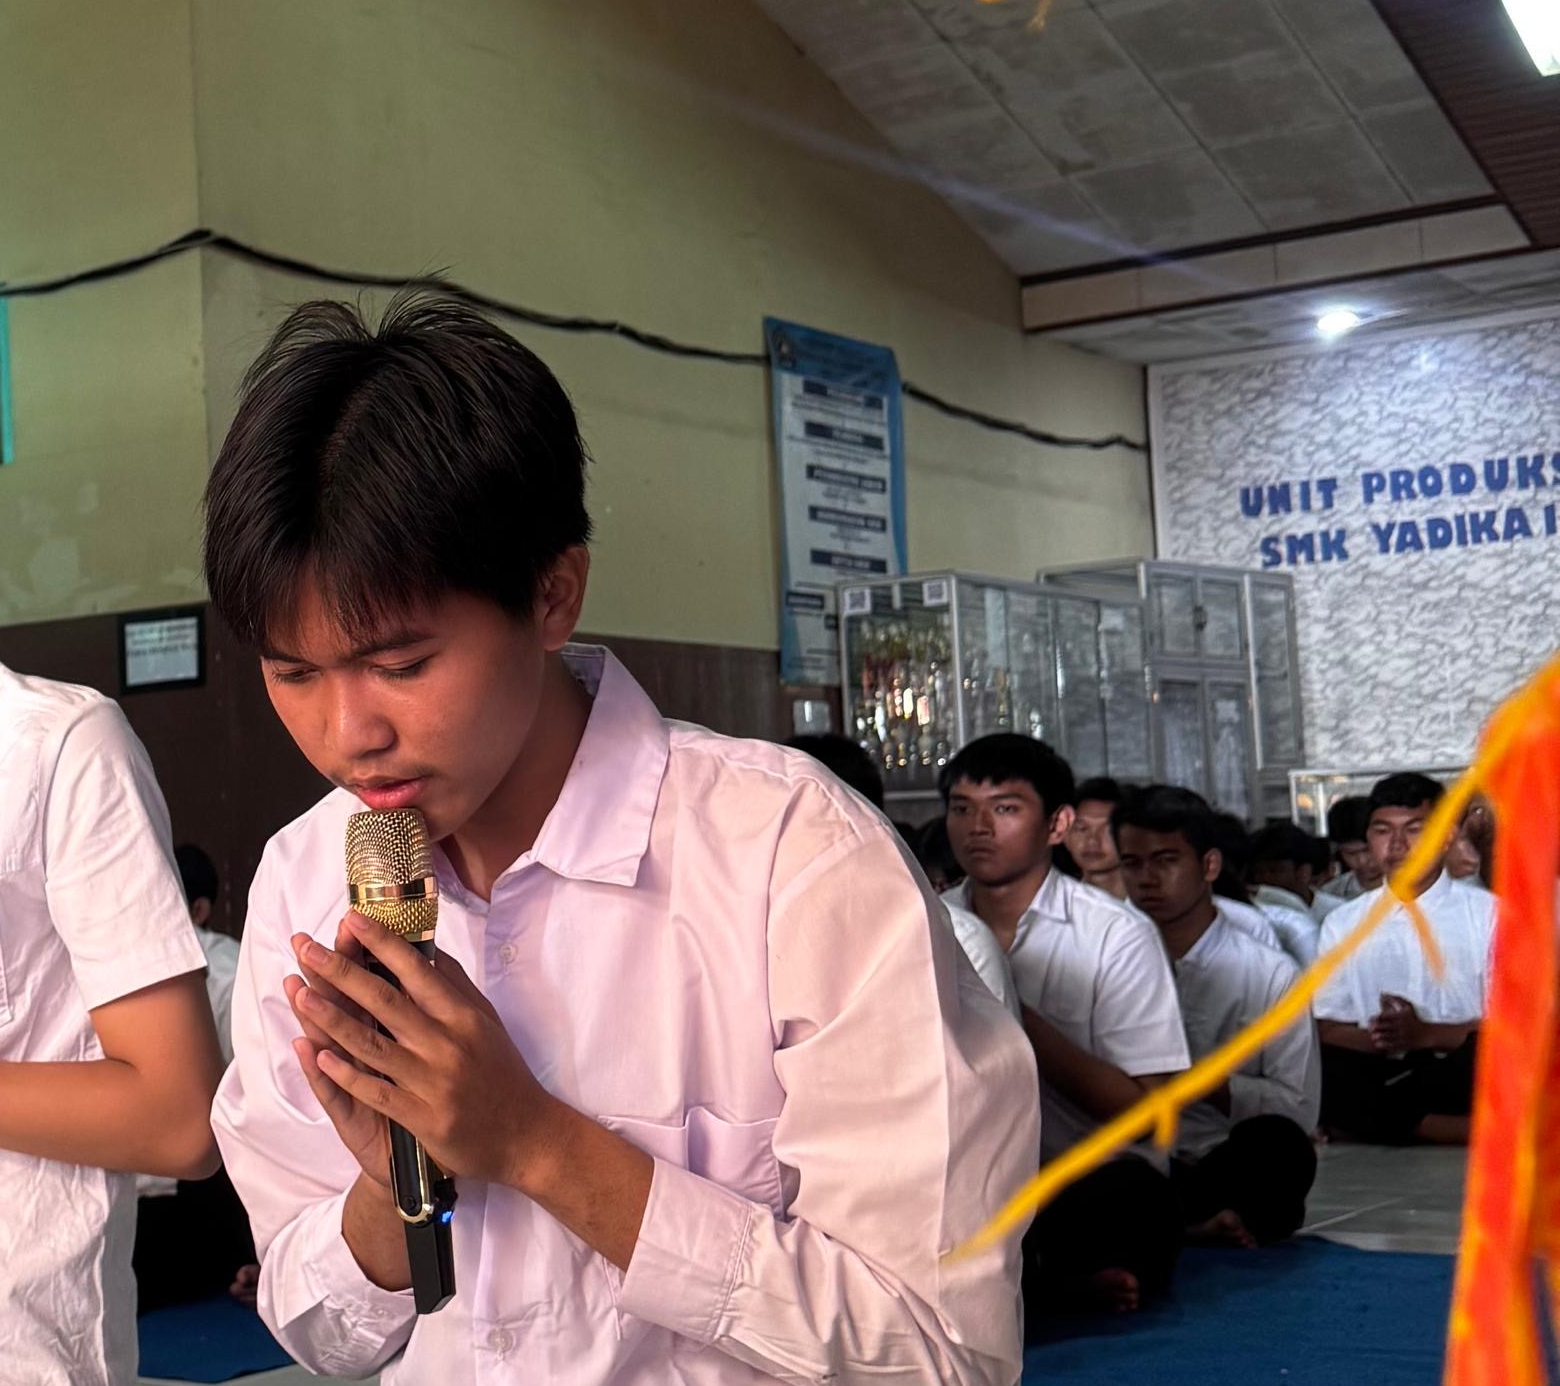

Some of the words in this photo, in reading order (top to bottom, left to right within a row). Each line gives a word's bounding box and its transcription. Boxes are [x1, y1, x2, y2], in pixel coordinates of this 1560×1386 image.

[1241, 477, 1338, 518] UNIT
[1260, 529, 1349, 568] SMK
[1372, 507, 1532, 555] YADIKA
